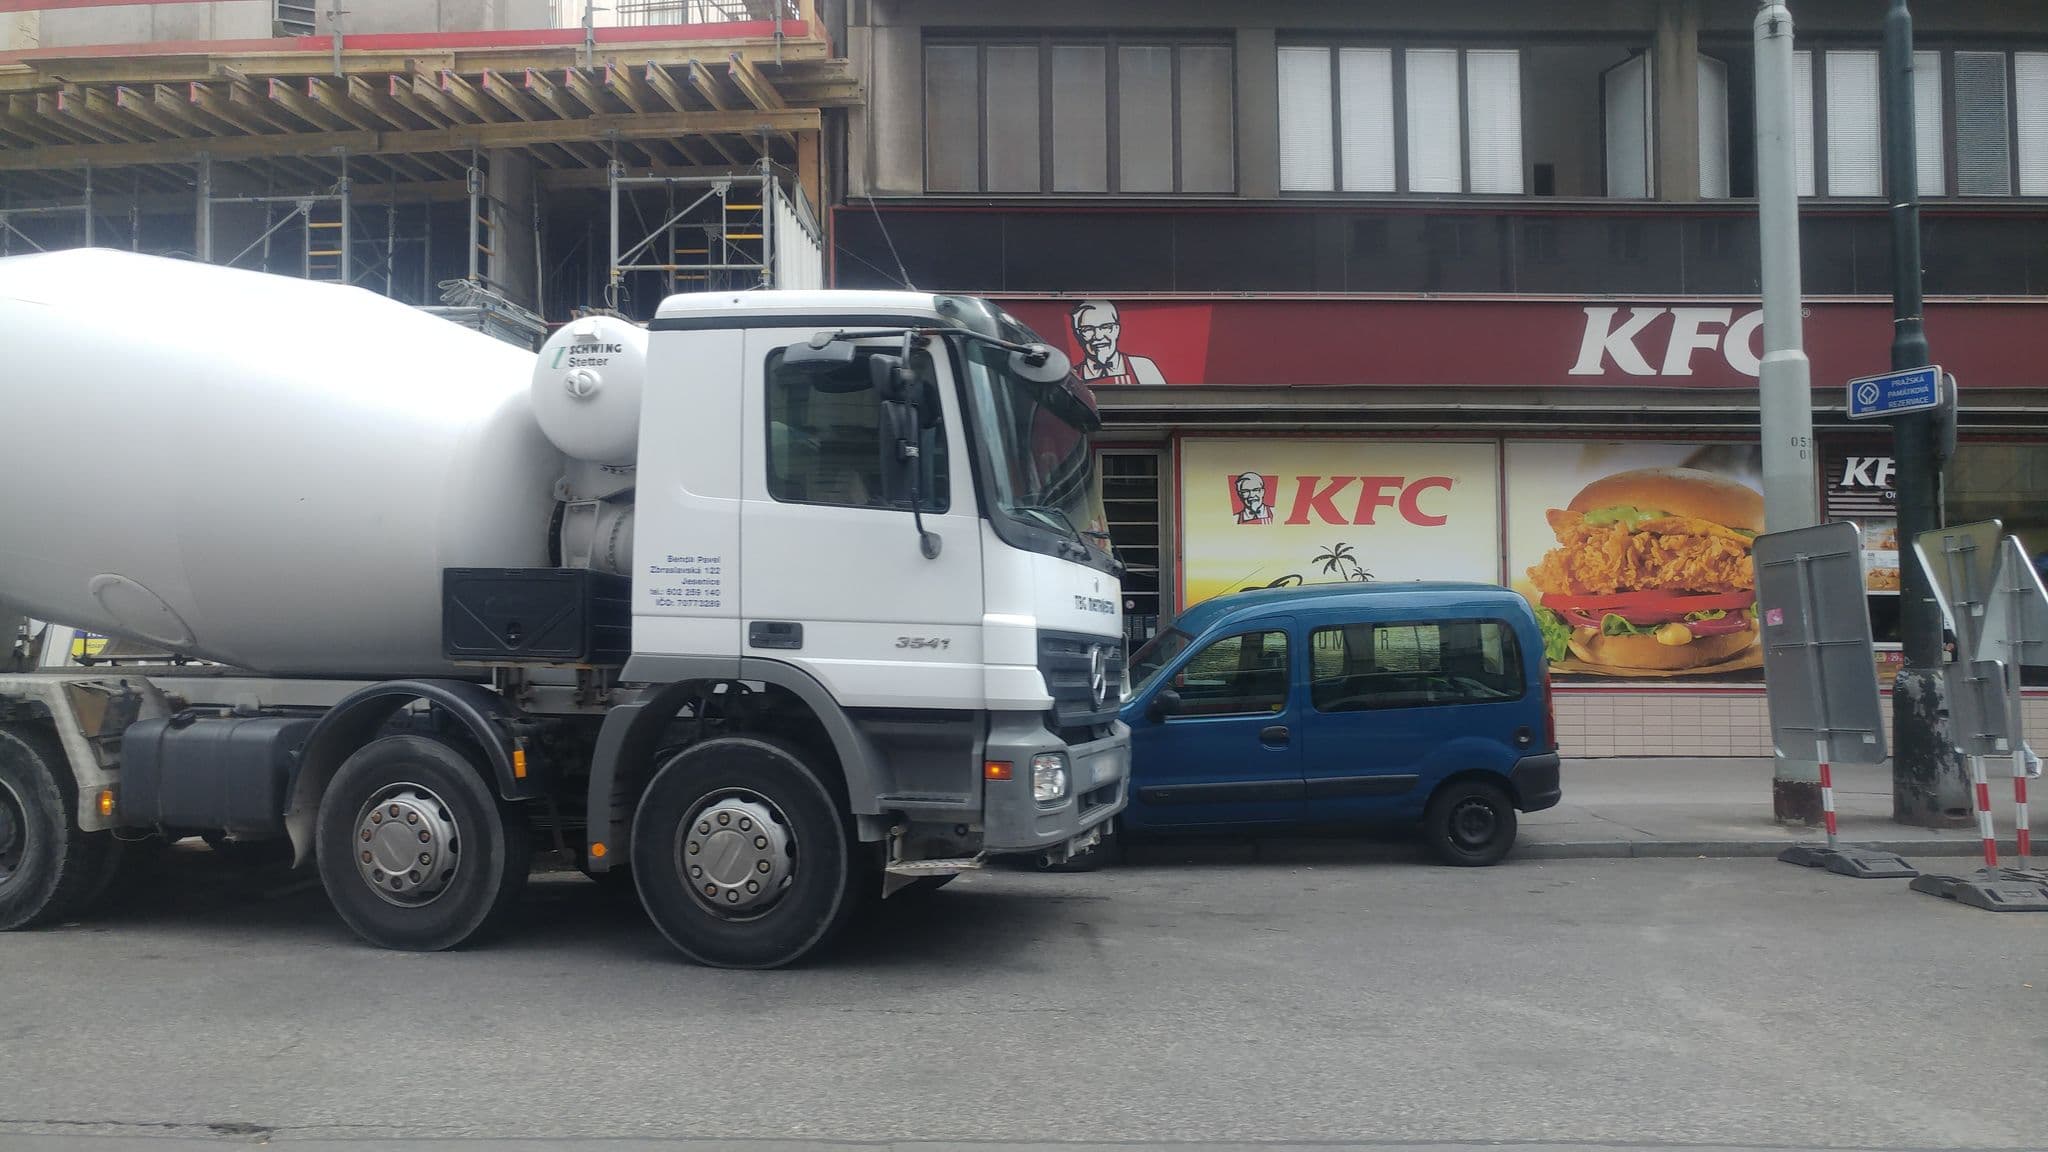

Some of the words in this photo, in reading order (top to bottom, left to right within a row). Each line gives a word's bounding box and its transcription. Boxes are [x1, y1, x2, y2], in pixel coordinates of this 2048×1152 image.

[569, 343, 622, 355] SCHWING
[568, 357, 608, 367] Stetter
[1891, 375, 1925, 387] PRAŽSKÁ
[1888, 396, 1928, 408] REZERVACE
[1284, 476, 1454, 527] KFC
[895, 636, 950, 650] 3541
